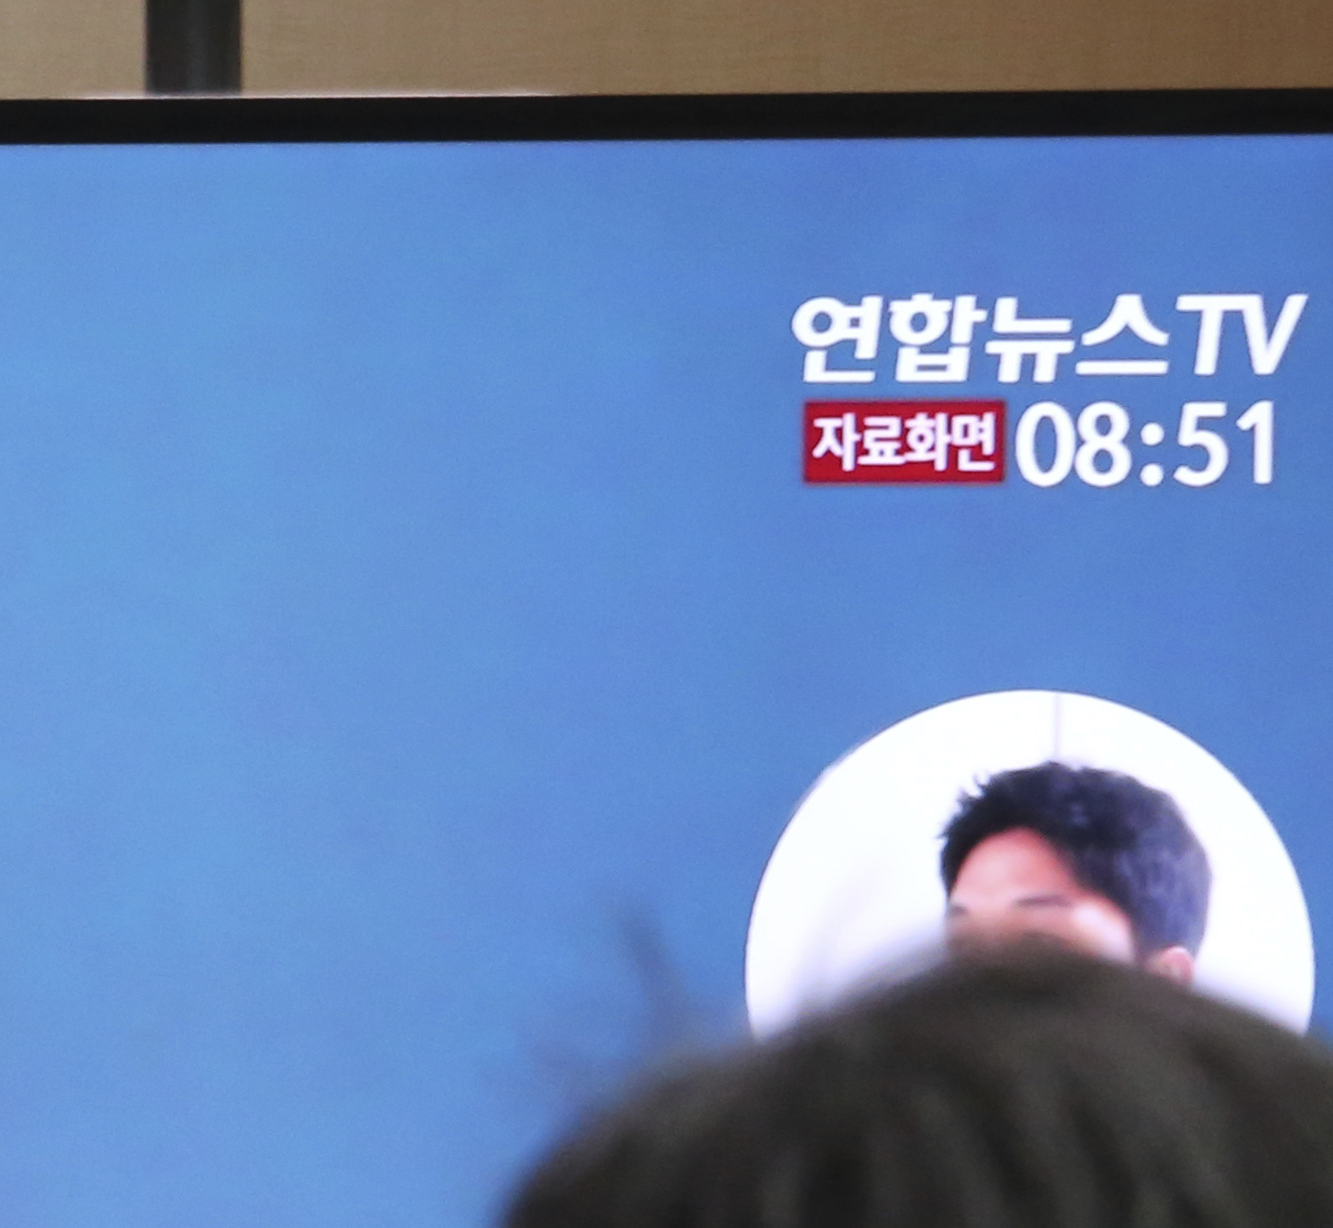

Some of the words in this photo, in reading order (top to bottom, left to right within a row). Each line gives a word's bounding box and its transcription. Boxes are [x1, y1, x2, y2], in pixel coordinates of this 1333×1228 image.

[790, 293, 1310, 384] 연합뉴스TV
[811, 411, 996, 473] 자료화면
[1014, 400, 1276, 488] 08:51
